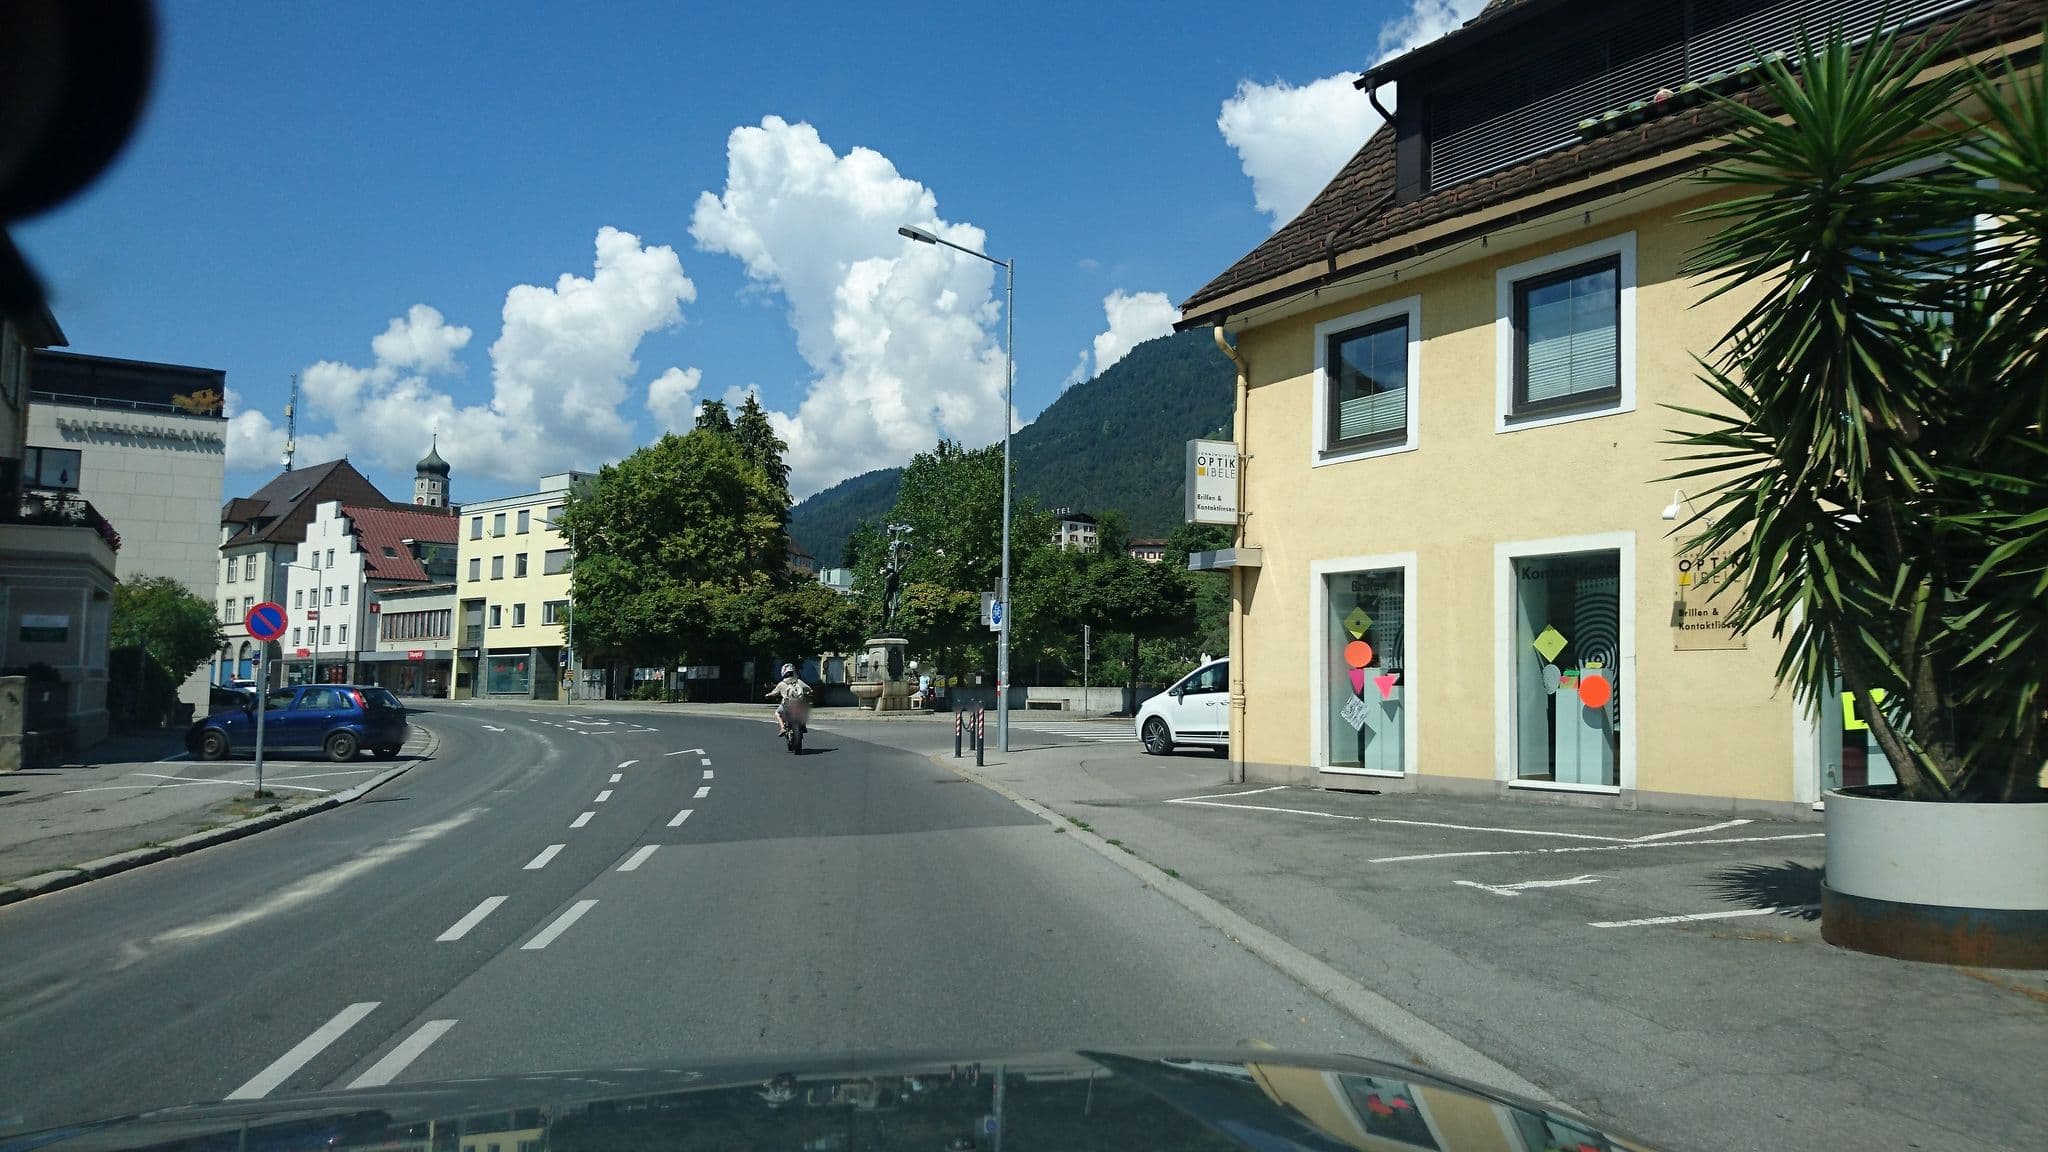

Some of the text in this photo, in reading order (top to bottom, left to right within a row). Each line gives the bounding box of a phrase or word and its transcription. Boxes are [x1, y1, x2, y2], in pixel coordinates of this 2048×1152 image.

[1197, 456, 1236, 469] OPTIK
[1206, 467, 1236, 479] IBELE
[1197, 503, 1236, 513] Kontaktlinsen
[1678, 607, 1719, 617] Brillen &
[1679, 621, 1738, 631] Kontaktlinse
